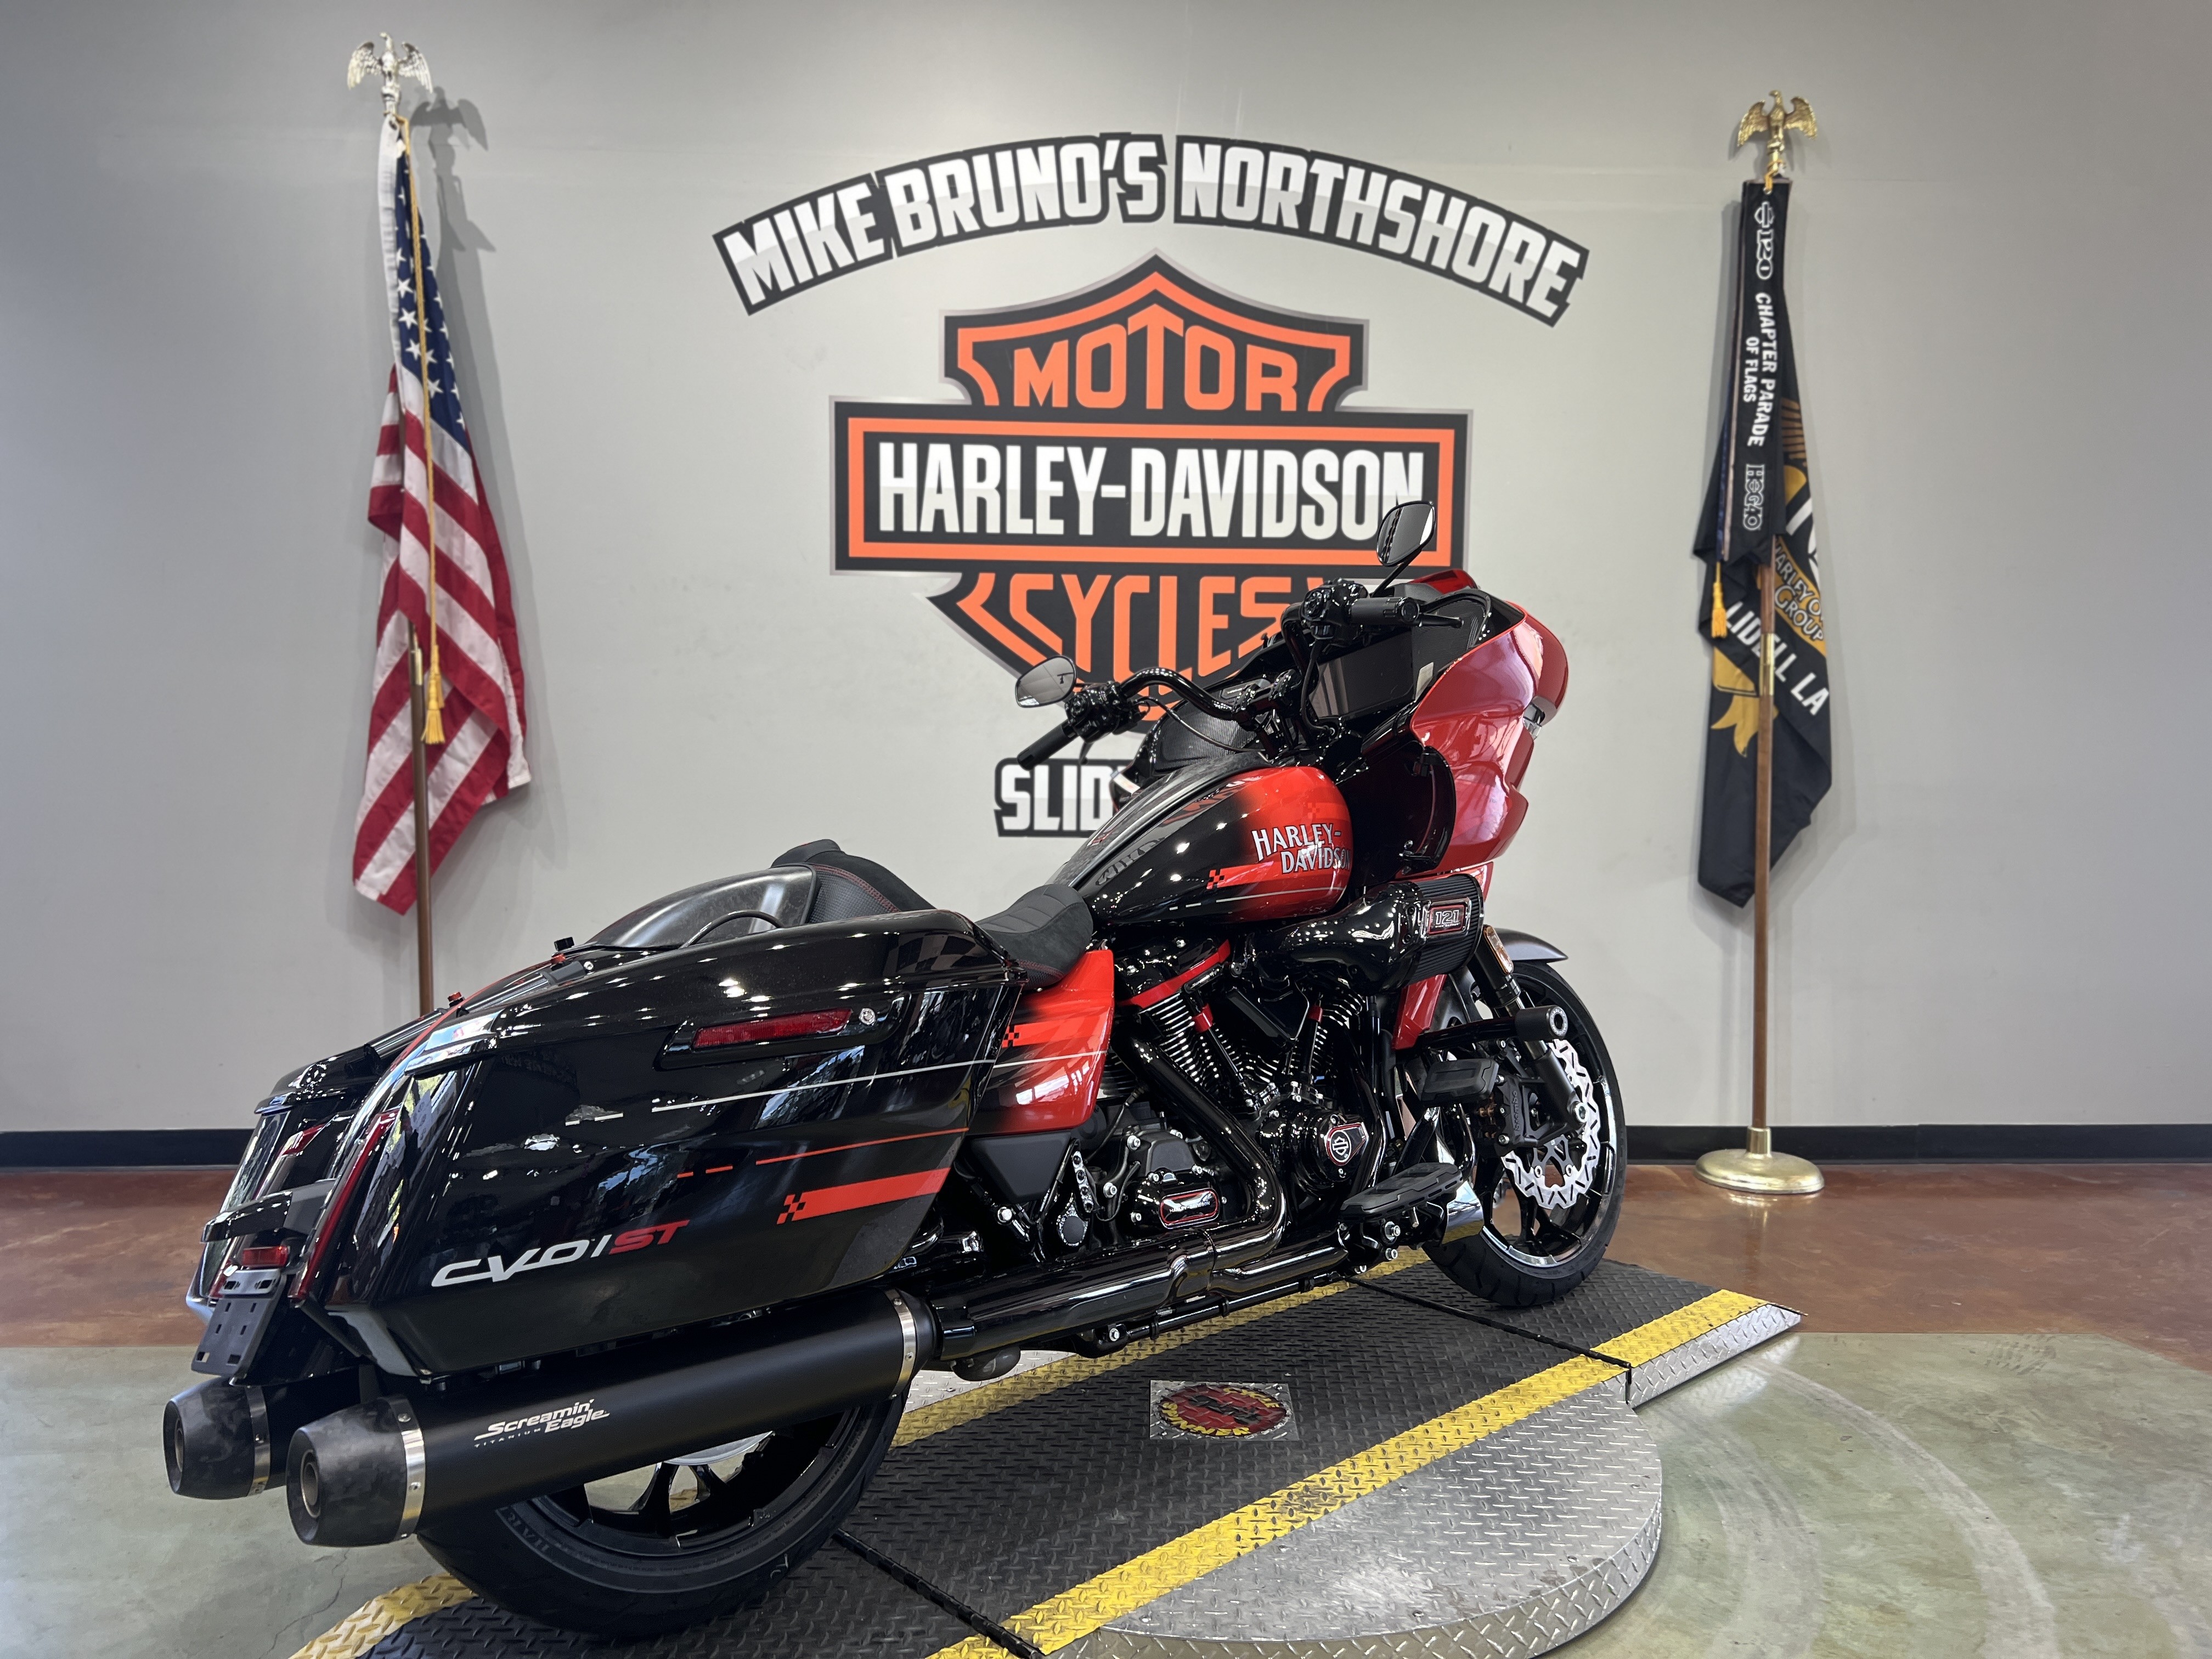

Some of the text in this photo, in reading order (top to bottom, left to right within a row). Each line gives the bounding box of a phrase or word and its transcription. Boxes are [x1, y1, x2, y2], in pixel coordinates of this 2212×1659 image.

[722, 139, 1581, 318] MIKE BRUNO'S NORTHSHORE
[1013, 303, 1298, 412] MOTOR
[1743, 336, 1759, 403] OF FLAGS
[1747, 292, 1778, 447] CHAPTER PARADE
[879, 442, 1425, 541] HARLEY-DAVIDSON
[1009, 573, 1292, 696] CYCLES
[1774, 584, 1824, 641] GROUP
[1790, 672, 1830, 716] LA
[1001, 764, 1126, 831] SLID
[1251, 823, 1342, 862] HARLEY-
[1280, 846, 1350, 874] DAVIDSON
[1435, 910, 1460, 925] 121
[474, 1427, 541, 1448] TITANIUM
[544, 1408, 610, 1434] Eagle
